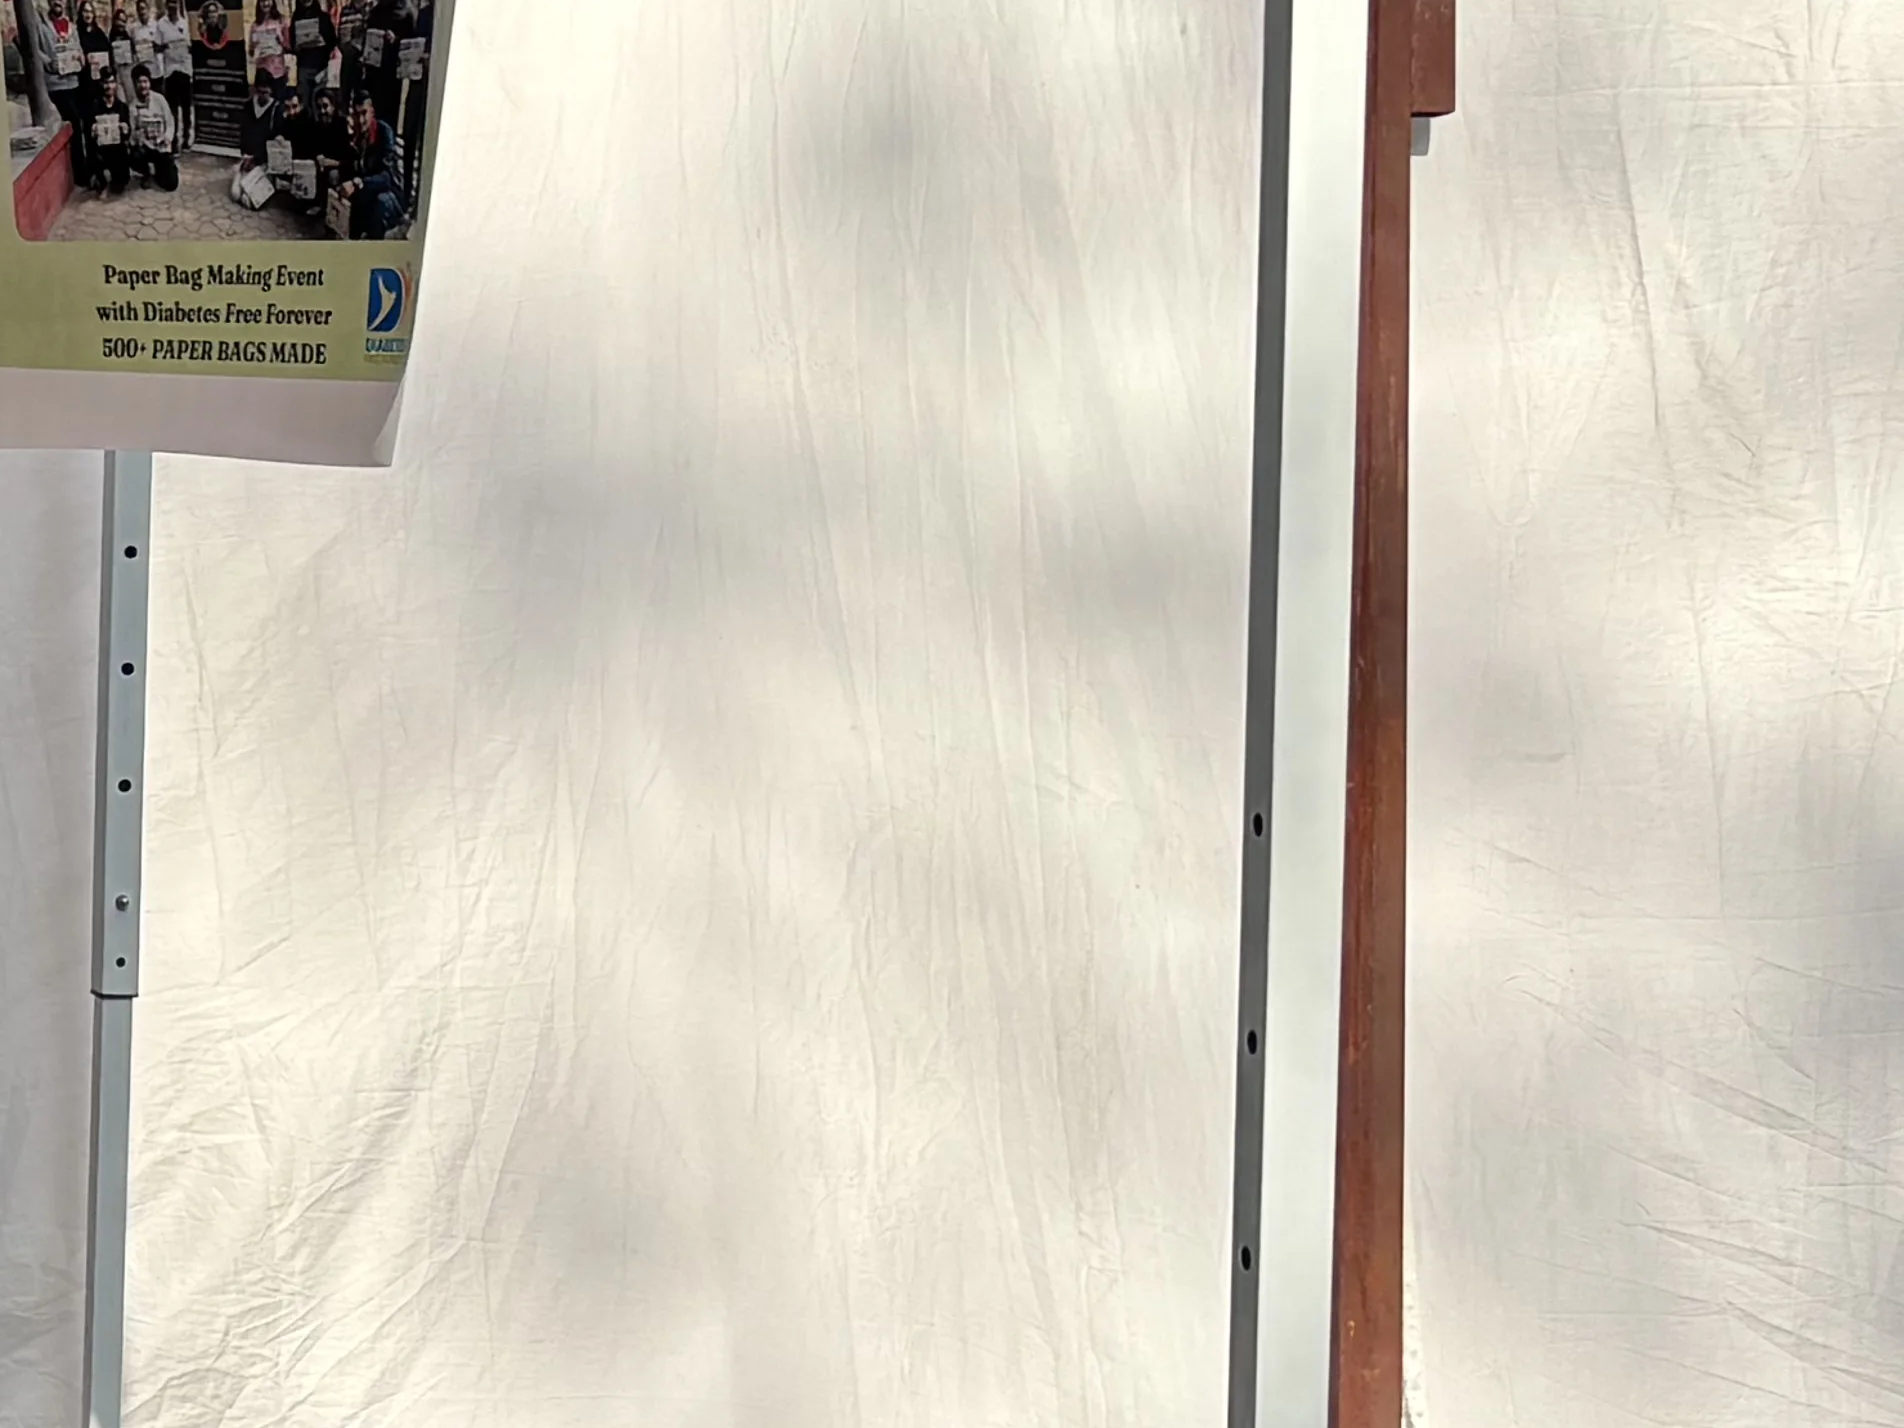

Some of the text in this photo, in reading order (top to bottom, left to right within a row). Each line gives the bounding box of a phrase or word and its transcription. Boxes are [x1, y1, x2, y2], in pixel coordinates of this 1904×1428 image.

[102, 263, 325, 292] Paper Bag Making Event
[96, 301, 333, 326] with Diabetes Free Forever
[102, 337, 328, 365] 500+ PAPER BAGS MADE
